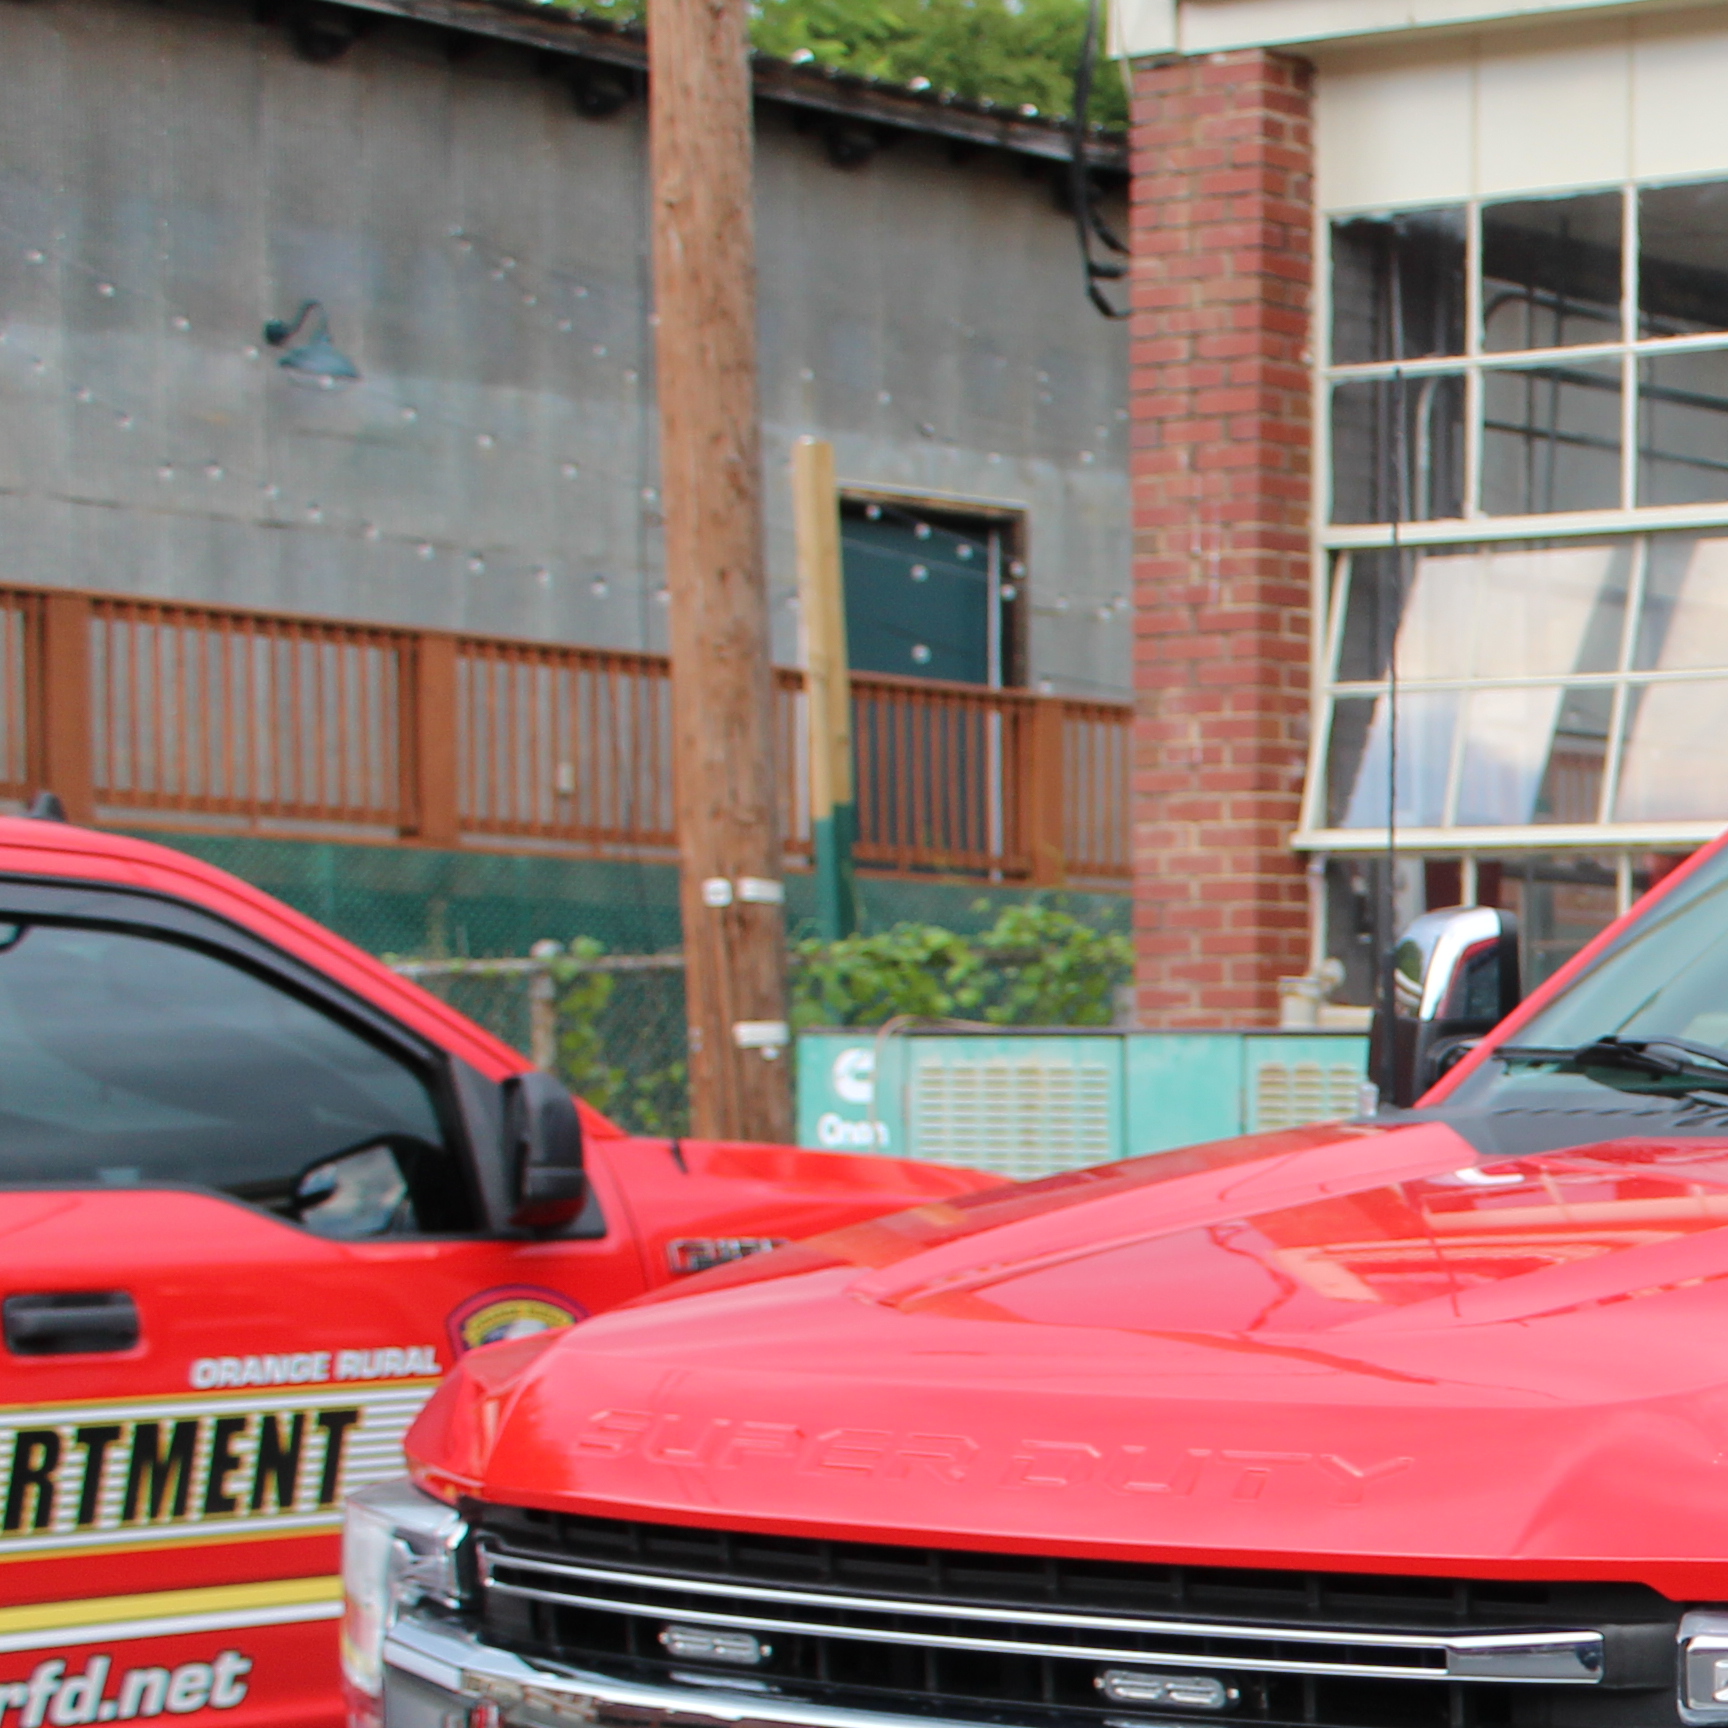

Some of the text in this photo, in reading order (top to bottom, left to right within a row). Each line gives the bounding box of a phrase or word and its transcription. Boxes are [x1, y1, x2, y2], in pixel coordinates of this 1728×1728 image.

[189, 1346, 442, 1389] ORANGE RURAL
[0, 1406, 364, 1535] RTMENT
[570, 1409, 1416, 1507] SUPER DUTY
